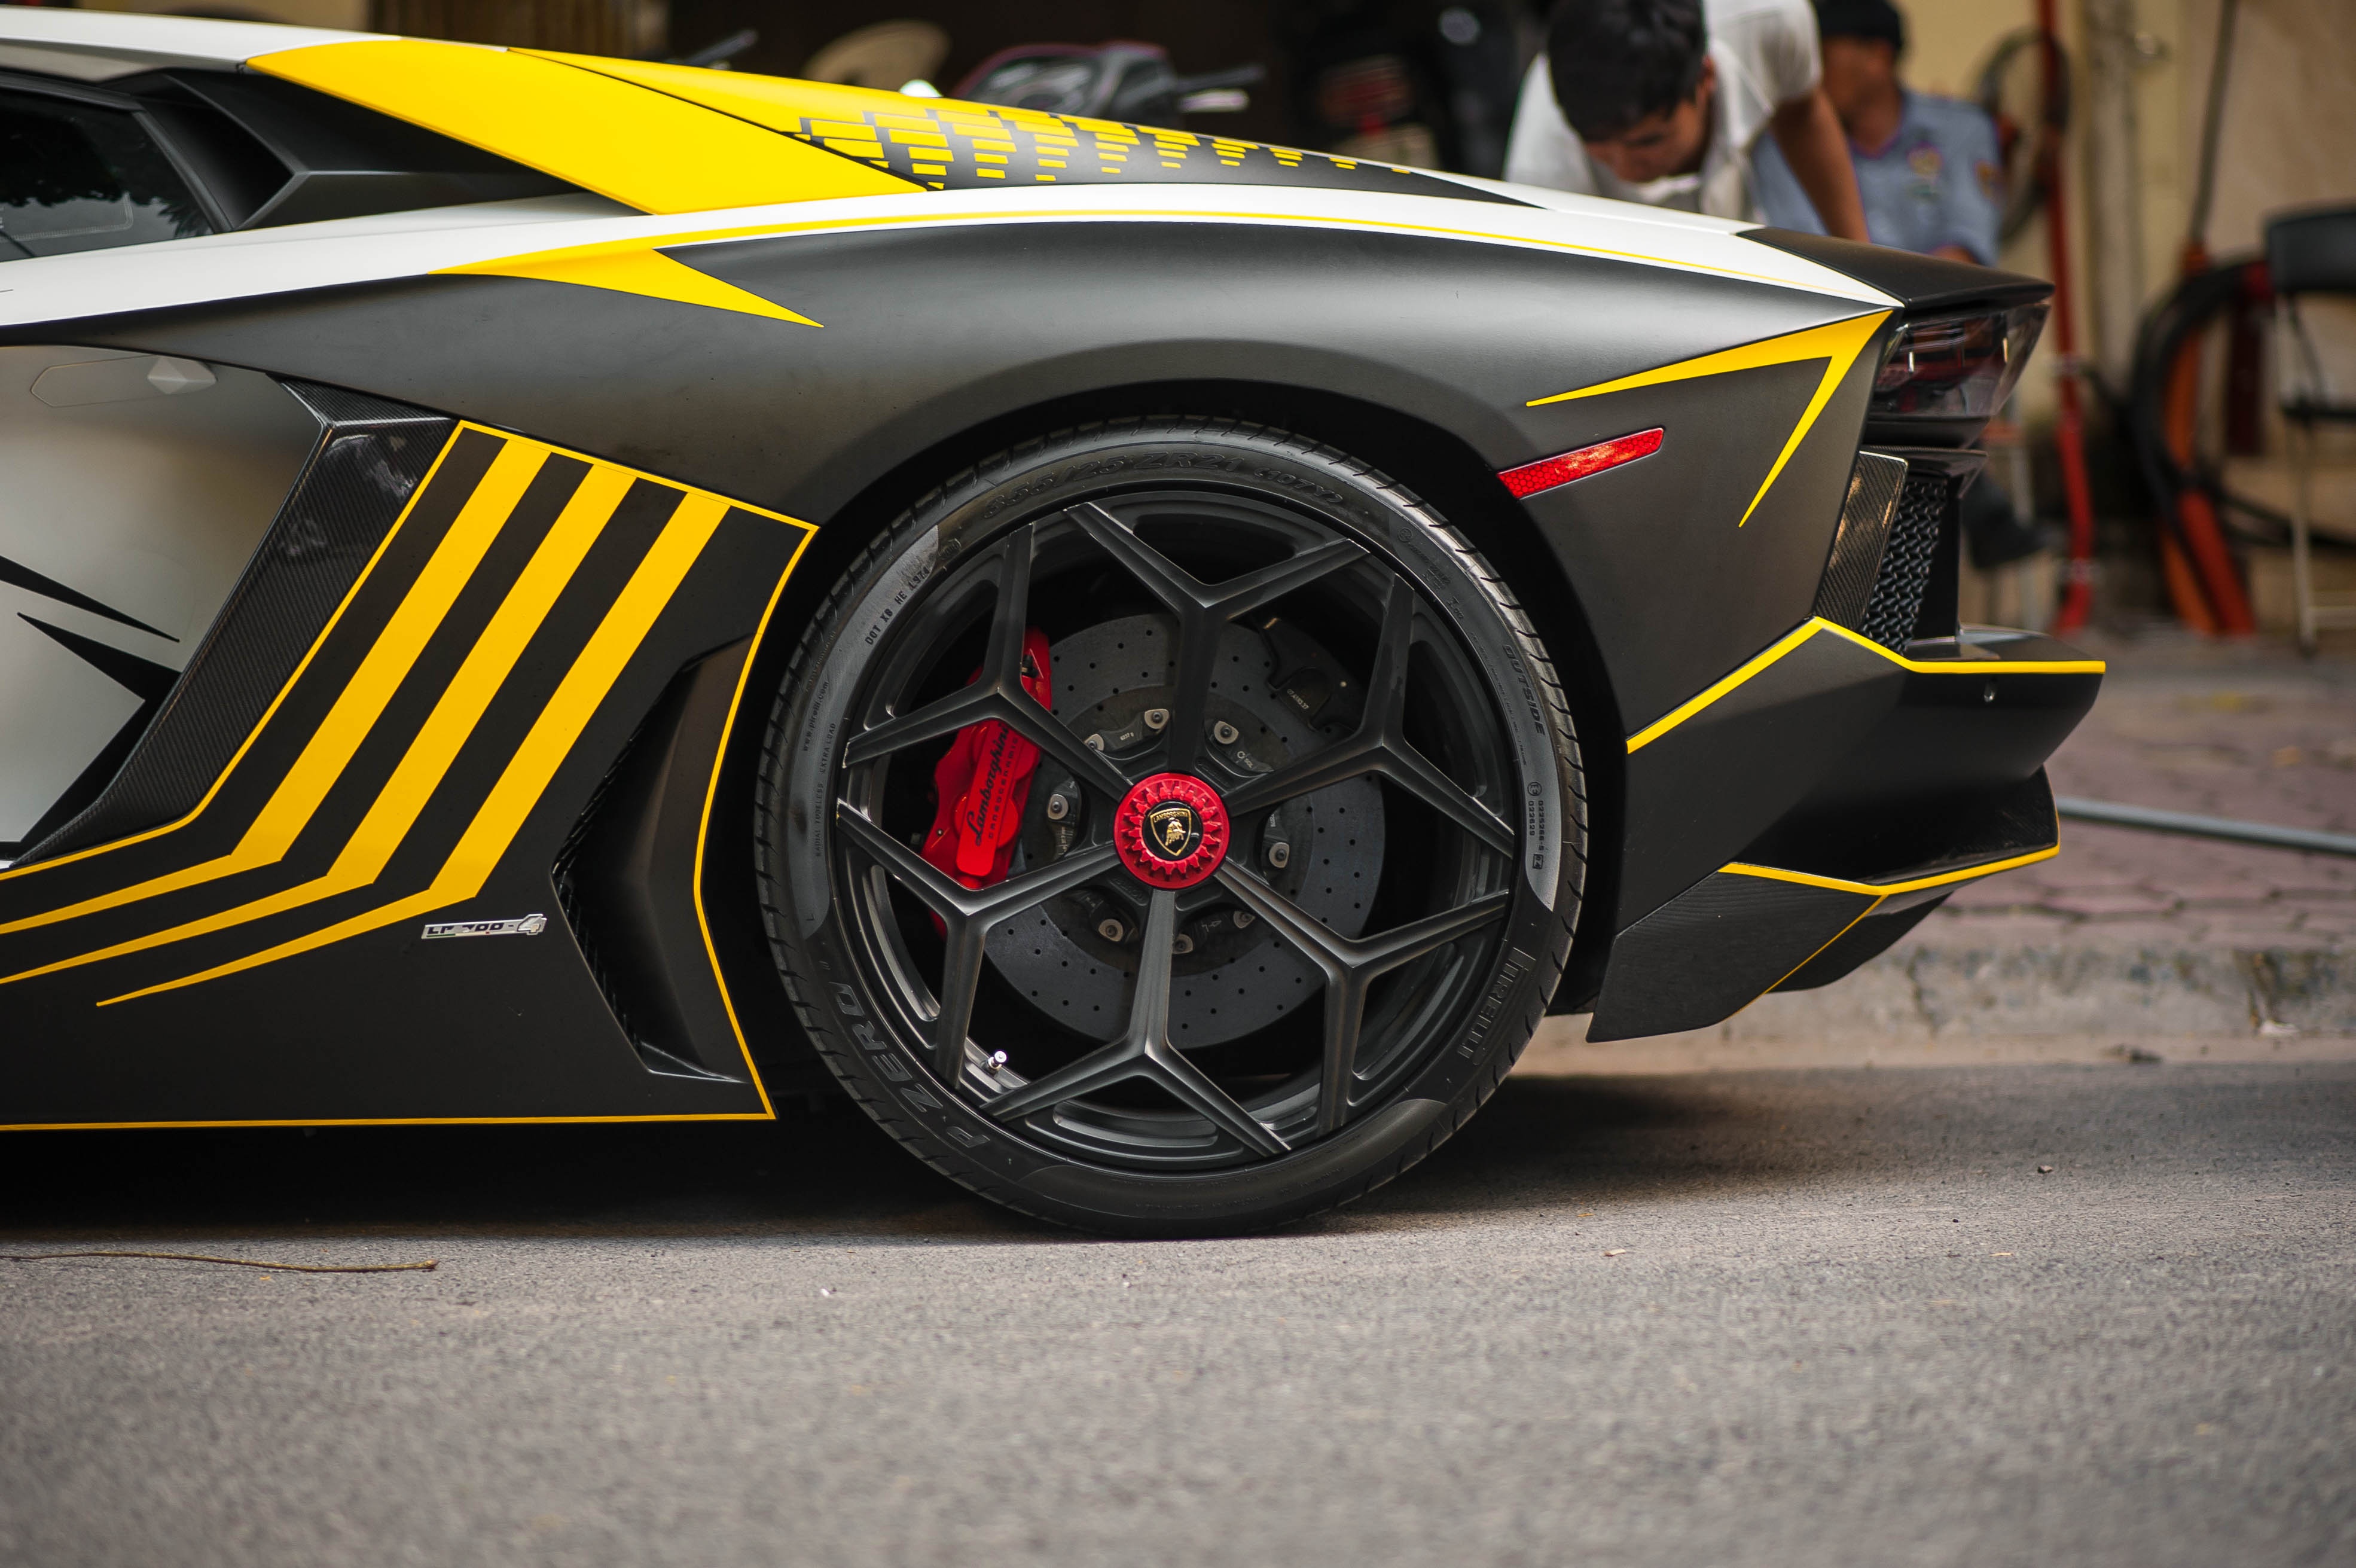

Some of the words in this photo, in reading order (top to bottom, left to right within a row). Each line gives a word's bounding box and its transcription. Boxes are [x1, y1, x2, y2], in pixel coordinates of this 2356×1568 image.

[864, 624, 881, 645] DOT
[894, 590, 907, 605] HE
[1503, 643, 1545, 736] OUTSIDE
[966, 722, 1009, 846] Lamborghini
[427, 926, 455, 935] LP
[829, 981, 944, 1114] ZERO
[1456, 946, 1536, 1066] PIRELLI
[946, 1125, 991, 1149] P
